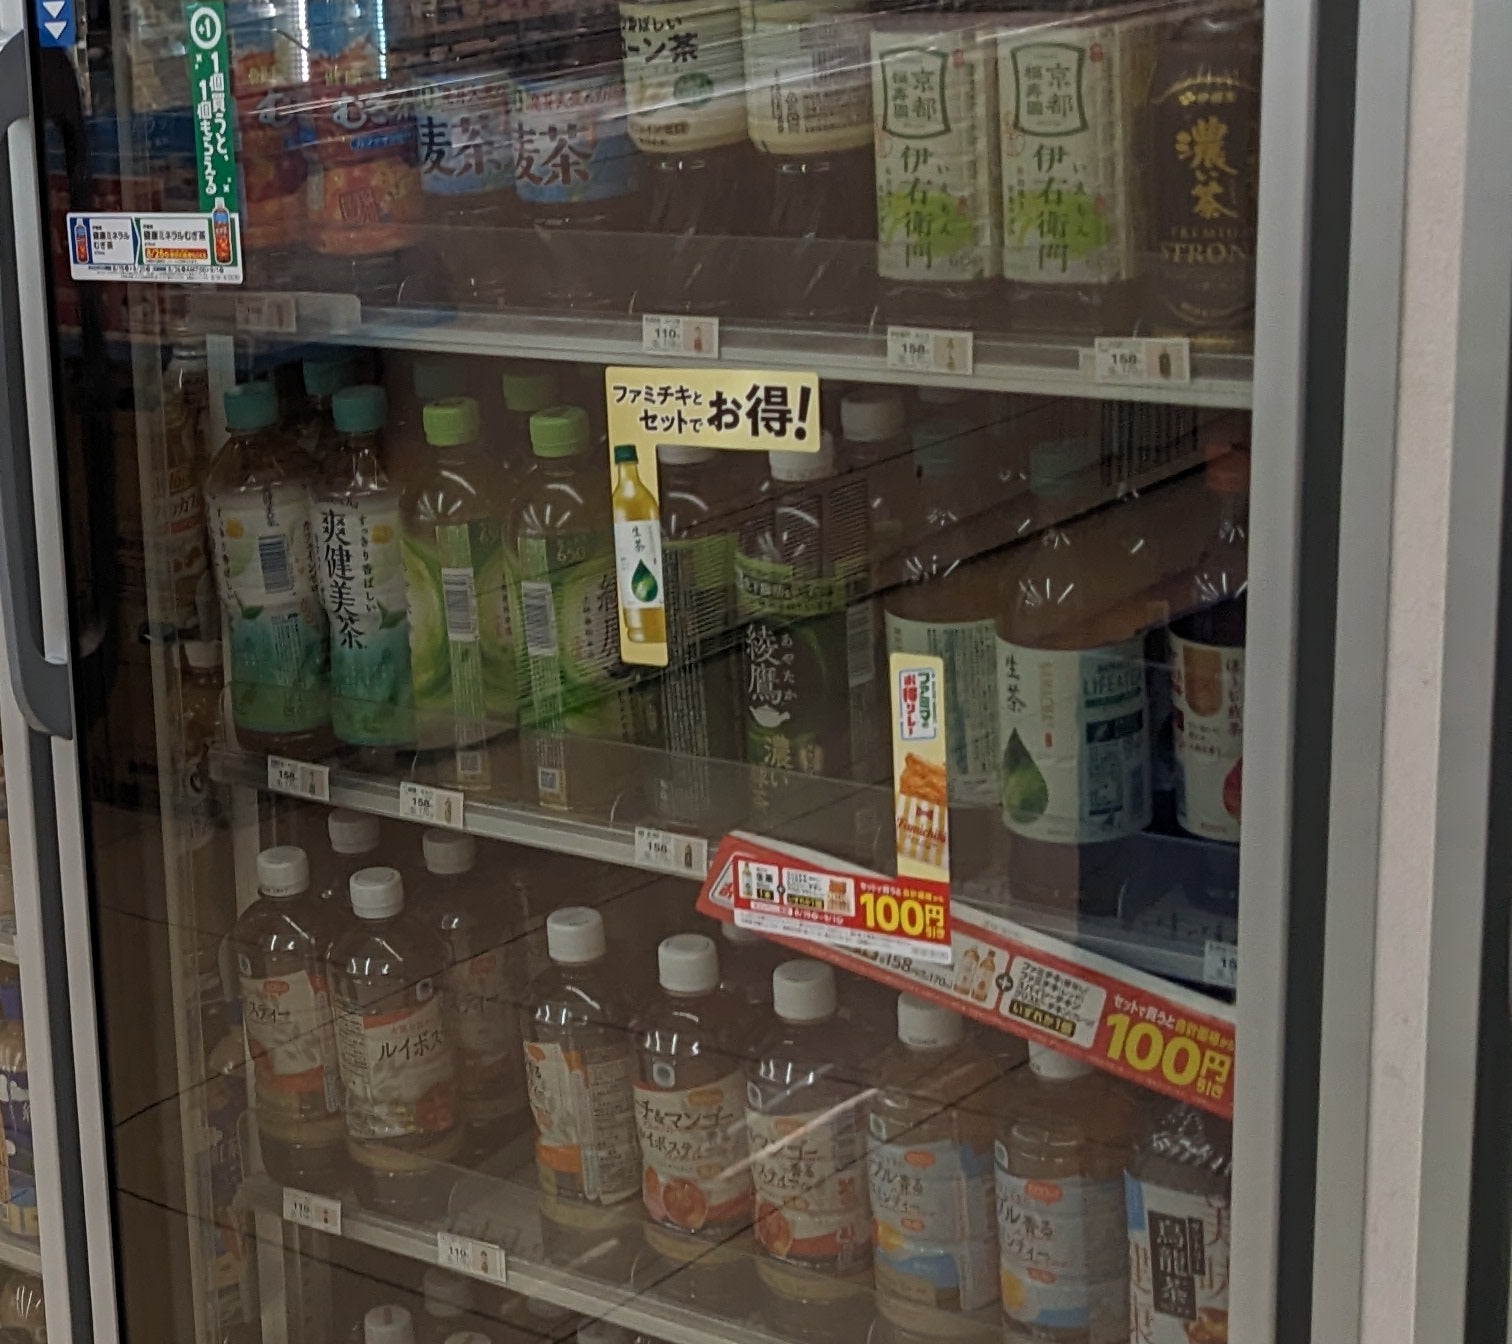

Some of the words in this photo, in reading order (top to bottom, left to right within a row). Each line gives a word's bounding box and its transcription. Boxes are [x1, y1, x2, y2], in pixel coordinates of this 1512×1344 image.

[612, 384, 702, 407] ファミチキと
[707, 383, 812, 441] お得!
[639, 408, 703, 434] セットで
[322, 509, 364, 649] 爽健美茶
